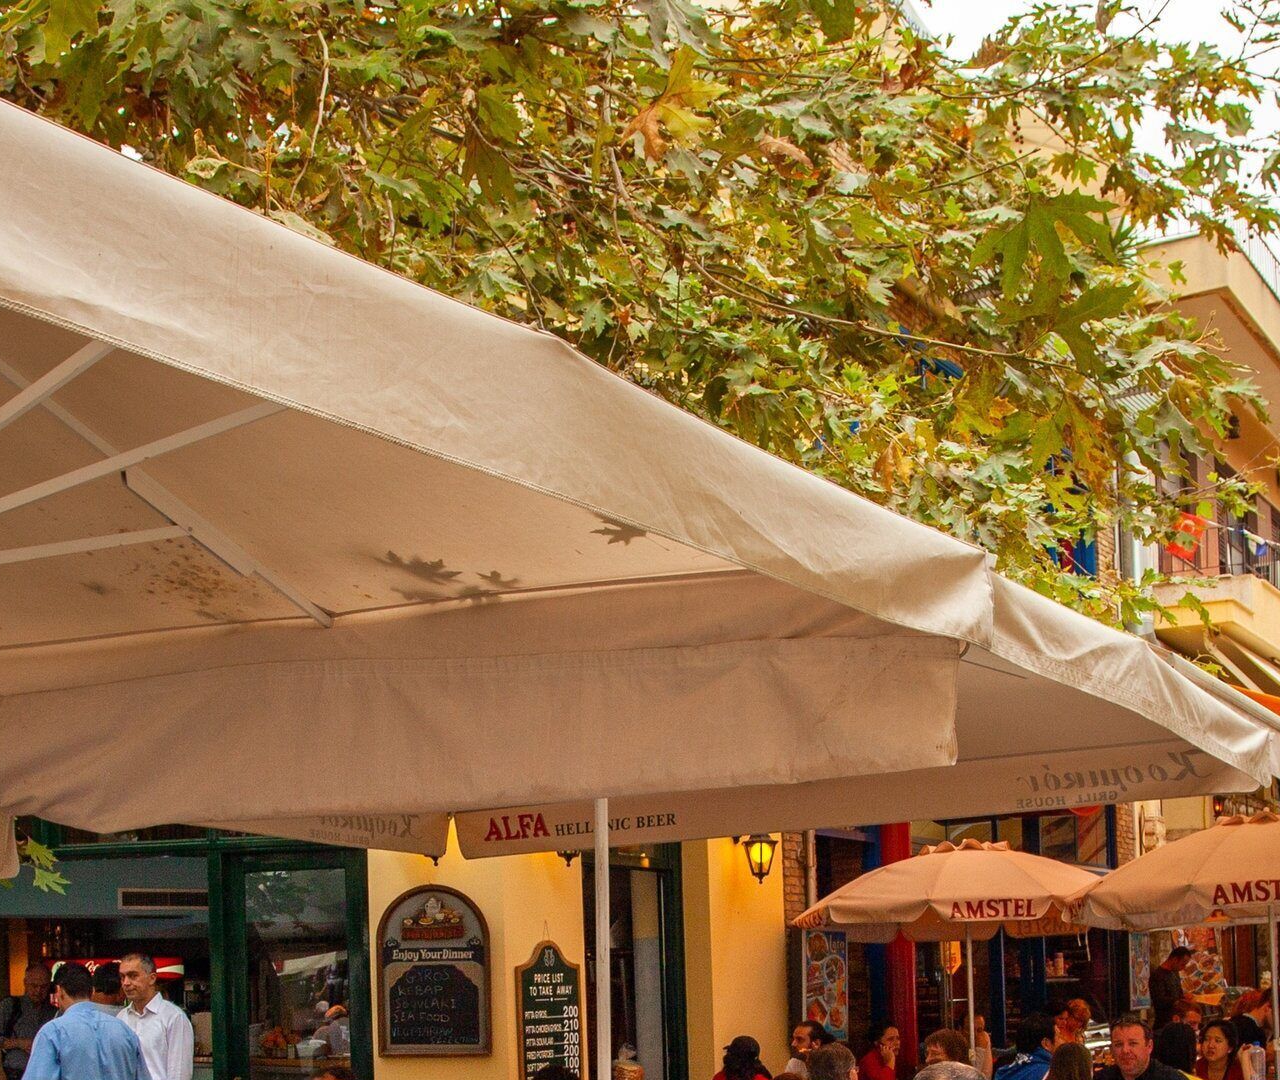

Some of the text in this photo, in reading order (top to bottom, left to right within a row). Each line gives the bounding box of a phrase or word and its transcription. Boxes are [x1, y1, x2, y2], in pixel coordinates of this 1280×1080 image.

[484, 812, 677, 843] ALFA HELLNIC BEER
[951, 898, 1037, 919] AMSTEL
[392, 949, 475, 962] Enjoy Your Dinner
[534, 973, 564, 983] PRICE LIST
[529, 985, 573, 996] TO TAKE AWAY
[563, 1005, 578, 1018] 200
[564, 1018, 579, 1031] 210
[564, 1032, 579, 1044] 200
[564, 1045, 579, 1056] 200
[564, 1057, 579, 1068] 100
